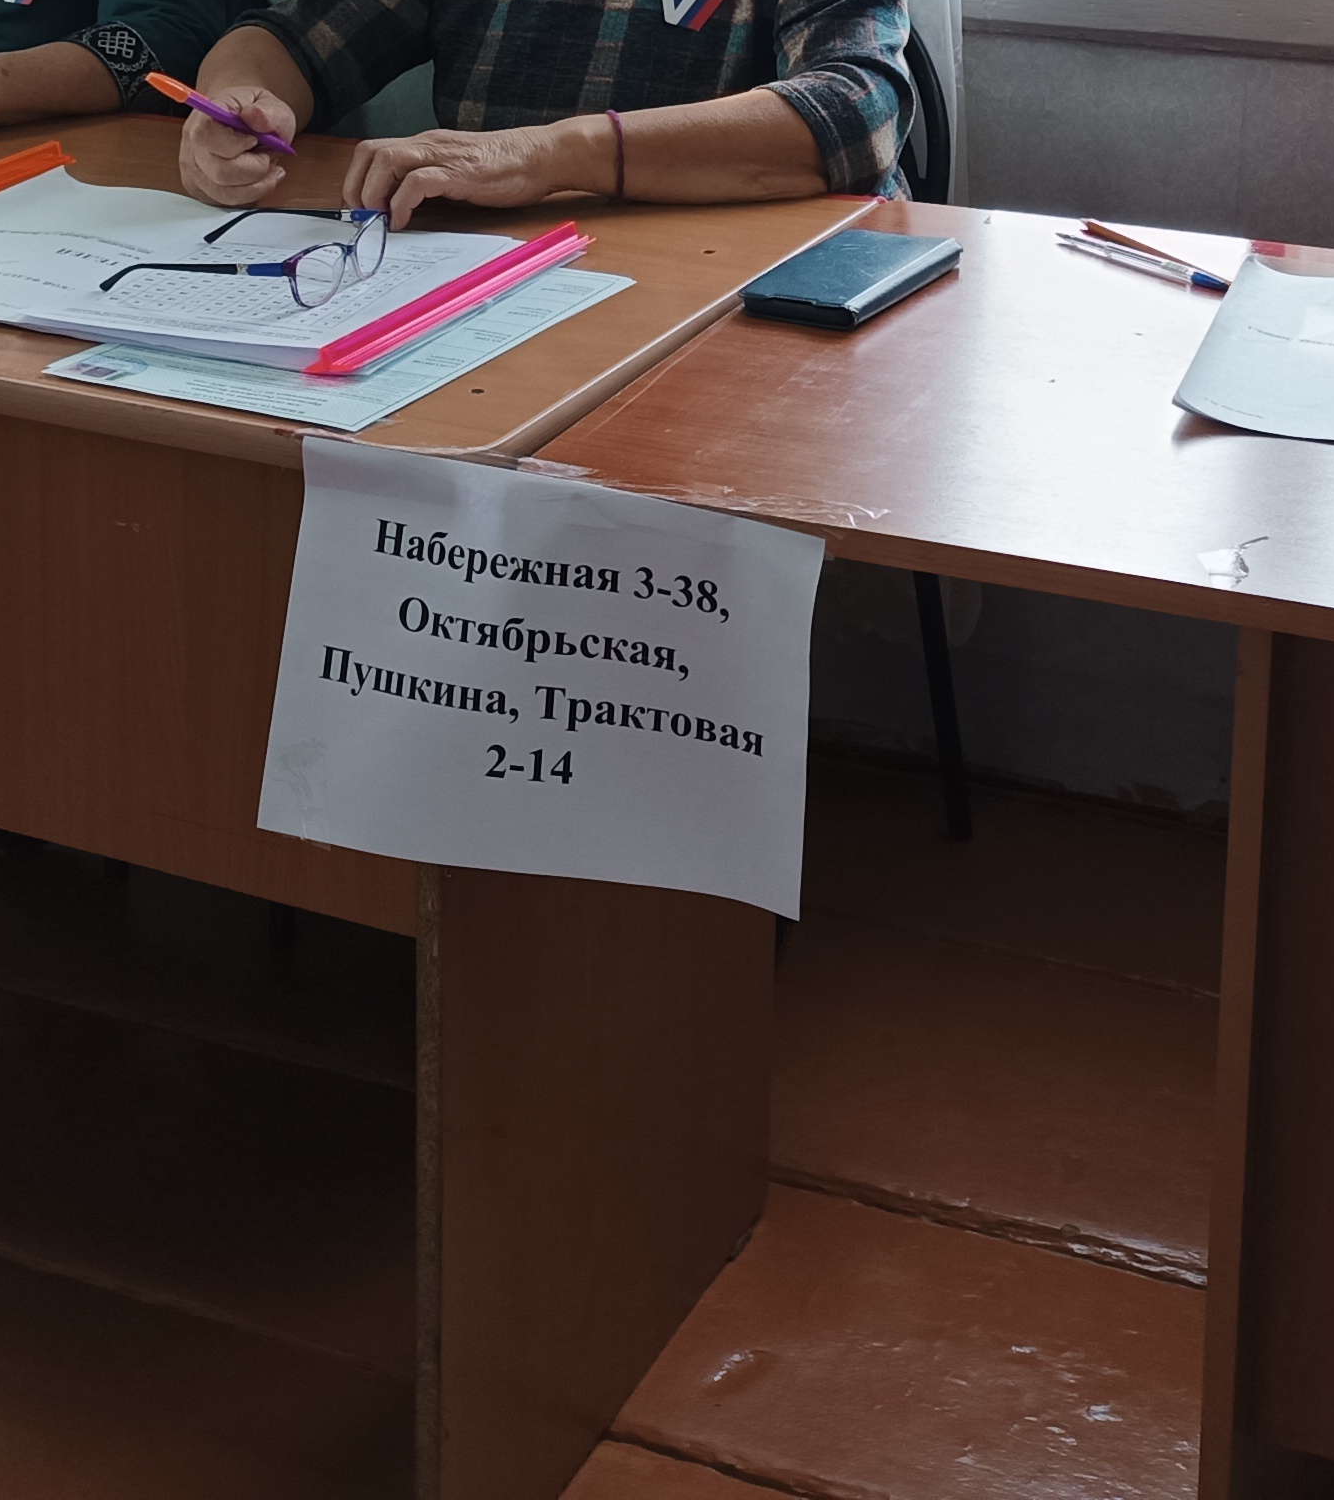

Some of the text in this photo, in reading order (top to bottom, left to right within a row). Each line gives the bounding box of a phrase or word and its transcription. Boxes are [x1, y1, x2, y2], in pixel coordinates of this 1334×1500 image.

[373, 517, 730, 623] Набережная 3-38,
[398, 596, 690, 680] Октябрьская,
[319, 645, 765, 758] Пушкина, Трактовая
[484, 744, 574, 784] 2-14
